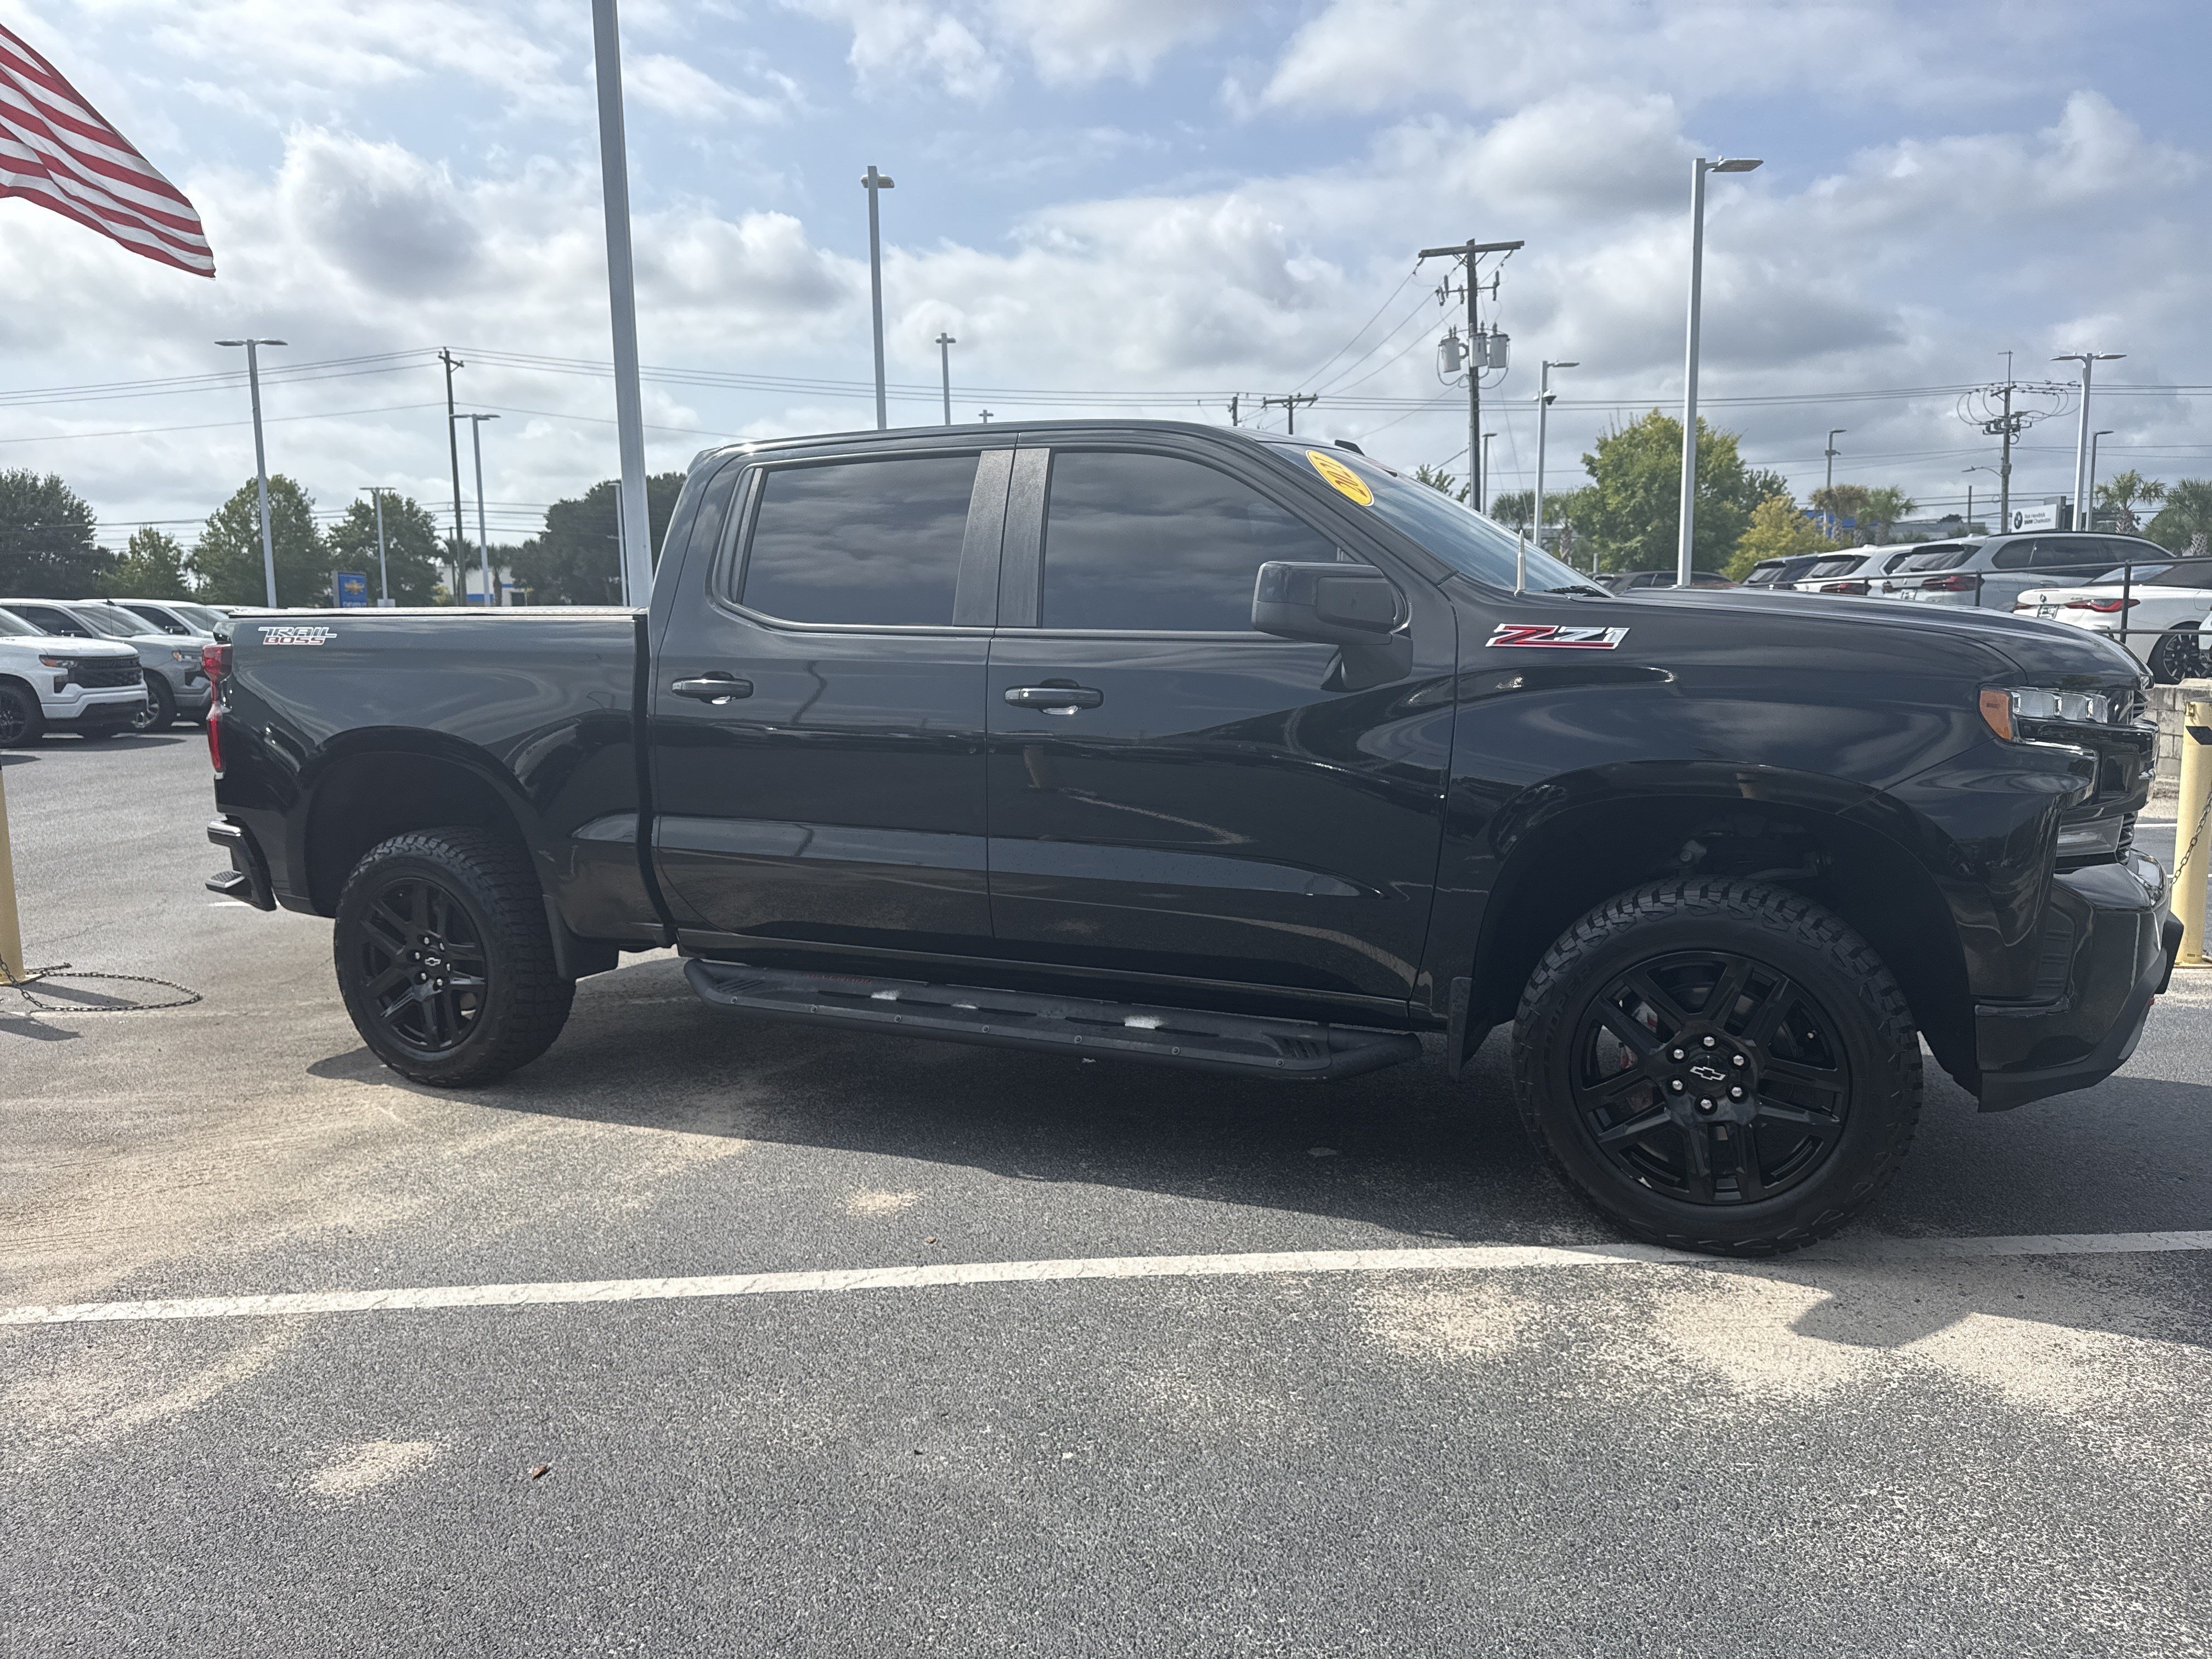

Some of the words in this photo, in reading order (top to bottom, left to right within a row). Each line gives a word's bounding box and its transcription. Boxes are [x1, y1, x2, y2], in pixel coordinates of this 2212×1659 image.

[1313, 455, 1368, 498] 2021
[258, 627, 337, 638] TRAIL
[263, 636, 326, 645] BOSS
[1485, 623, 1630, 650] Z71
